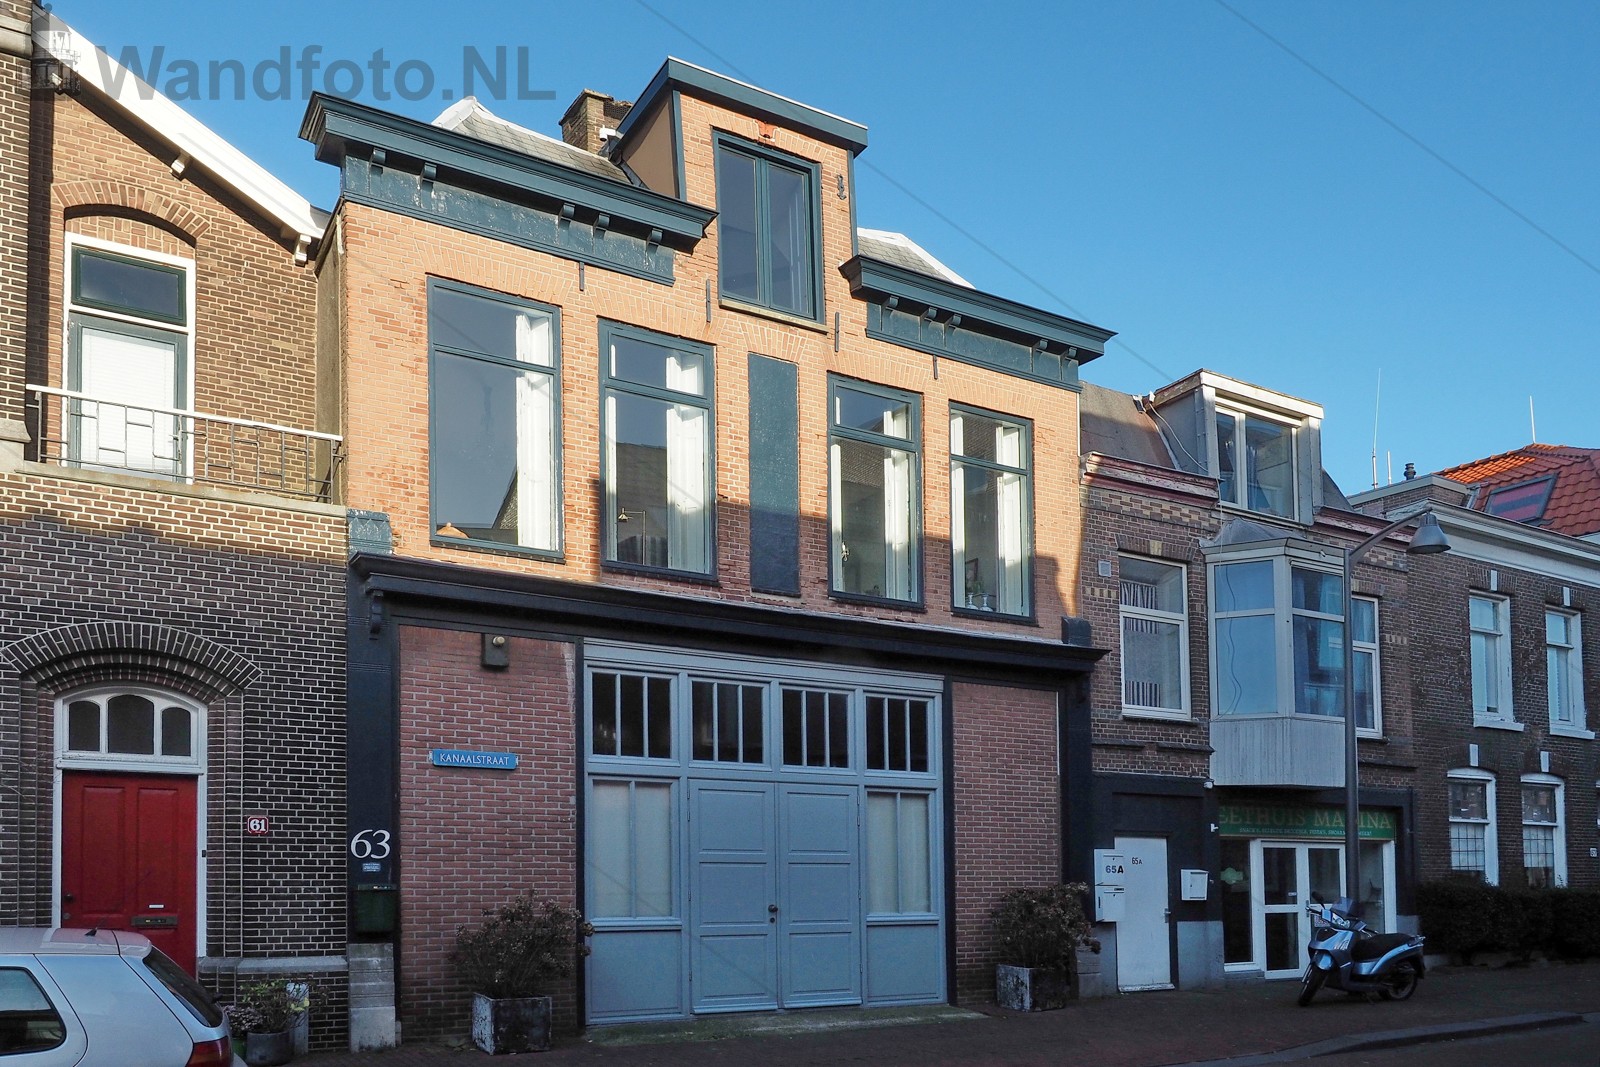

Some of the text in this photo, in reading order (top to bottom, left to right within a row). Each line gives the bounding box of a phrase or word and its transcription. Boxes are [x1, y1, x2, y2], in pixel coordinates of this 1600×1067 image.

[440, 753, 510, 766] KANAALSTRAAT
[1313, 808, 1392, 829] MAINA
[249, 819, 266, 831] 61
[350, 829, 391, 859] 63
[1131, 857, 1143, 865] 65A
[1105, 865, 1124, 874] 65A
